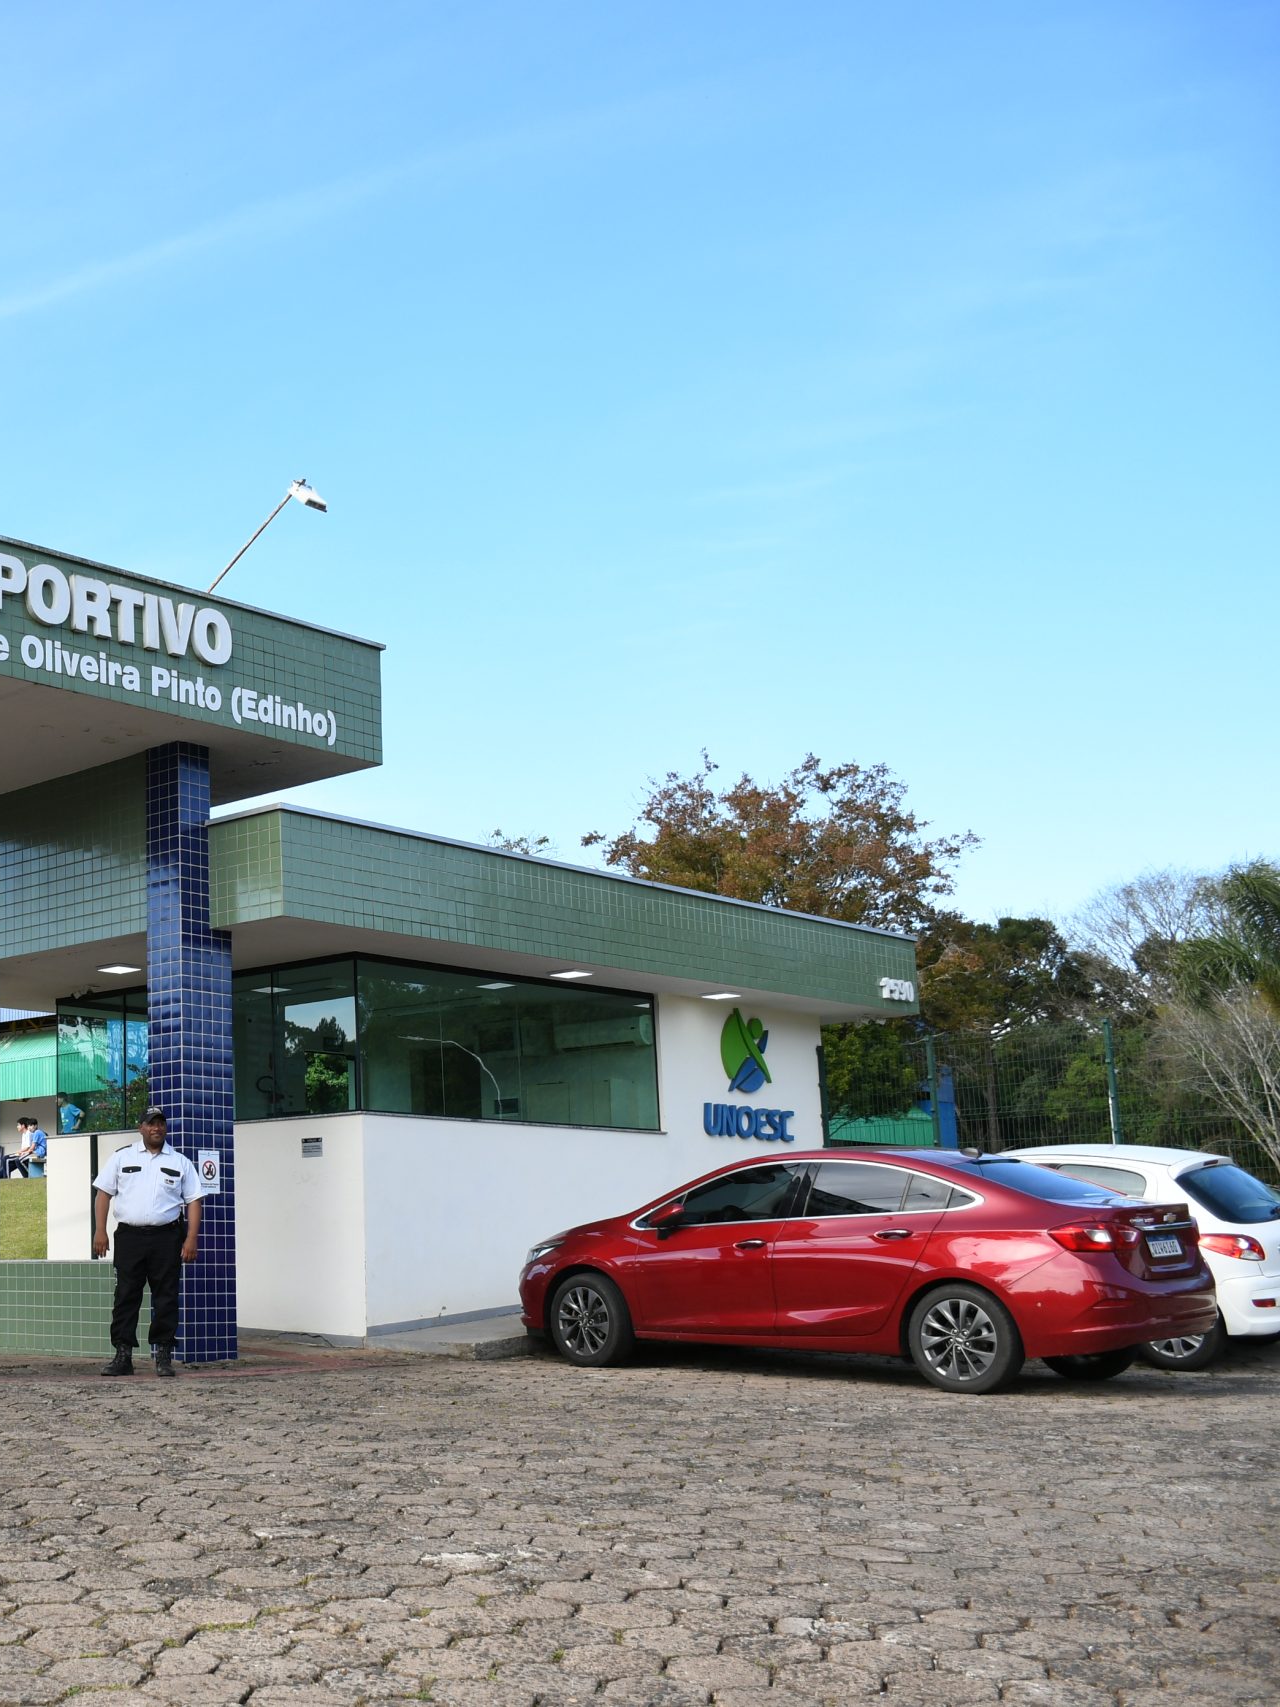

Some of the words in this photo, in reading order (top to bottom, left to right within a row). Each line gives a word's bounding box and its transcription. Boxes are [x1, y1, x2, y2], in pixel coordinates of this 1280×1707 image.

[21, 635, 141, 693] Oliveira
[152, 666, 222, 712] Pinto
[232, 687, 337, 747] (Edinho)
[880, 977, 915, 1002] 1590
[703, 1102, 795, 1142] UNOESC
